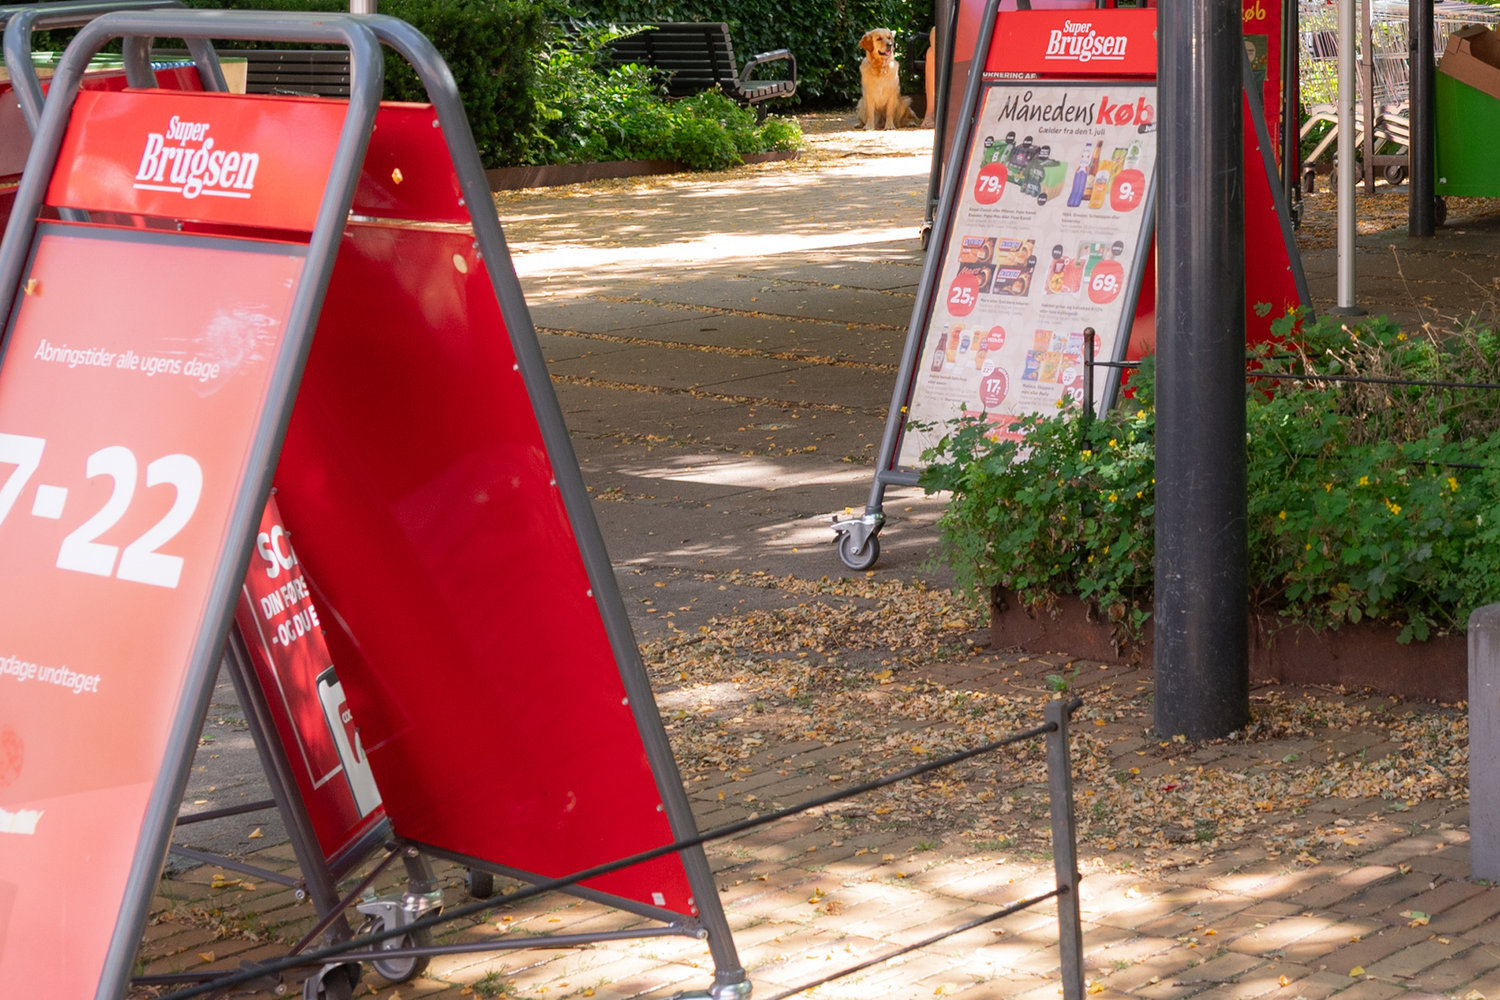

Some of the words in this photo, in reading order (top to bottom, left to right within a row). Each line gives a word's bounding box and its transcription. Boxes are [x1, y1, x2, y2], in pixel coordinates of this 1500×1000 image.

[1242, 0, 1267, 22] øb
[1063, 20, 1092, 35] Super
[1045, 29, 1127, 62] Brugsen
[998, 90, 1095, 126] Månedens
[1096, 96, 1154, 126] køb
[166, 115, 210, 146] Super
[1063, 127, 1074, 135] fra
[1075, 127, 1088, 135] den
[1093, 128, 1105, 136] juli
[135, 133, 259, 199] Brugsen
[34, 338, 116, 368] Åbningstider
[116, 350, 139, 370] alle
[140, 357, 182, 376] ugens
[184, 357, 220, 382] dage
[257, 525, 298, 579] SC
[260, 590, 285, 620] DIN
[292, 609, 311, 638] DU
[37, 666, 101, 694] undtaget
